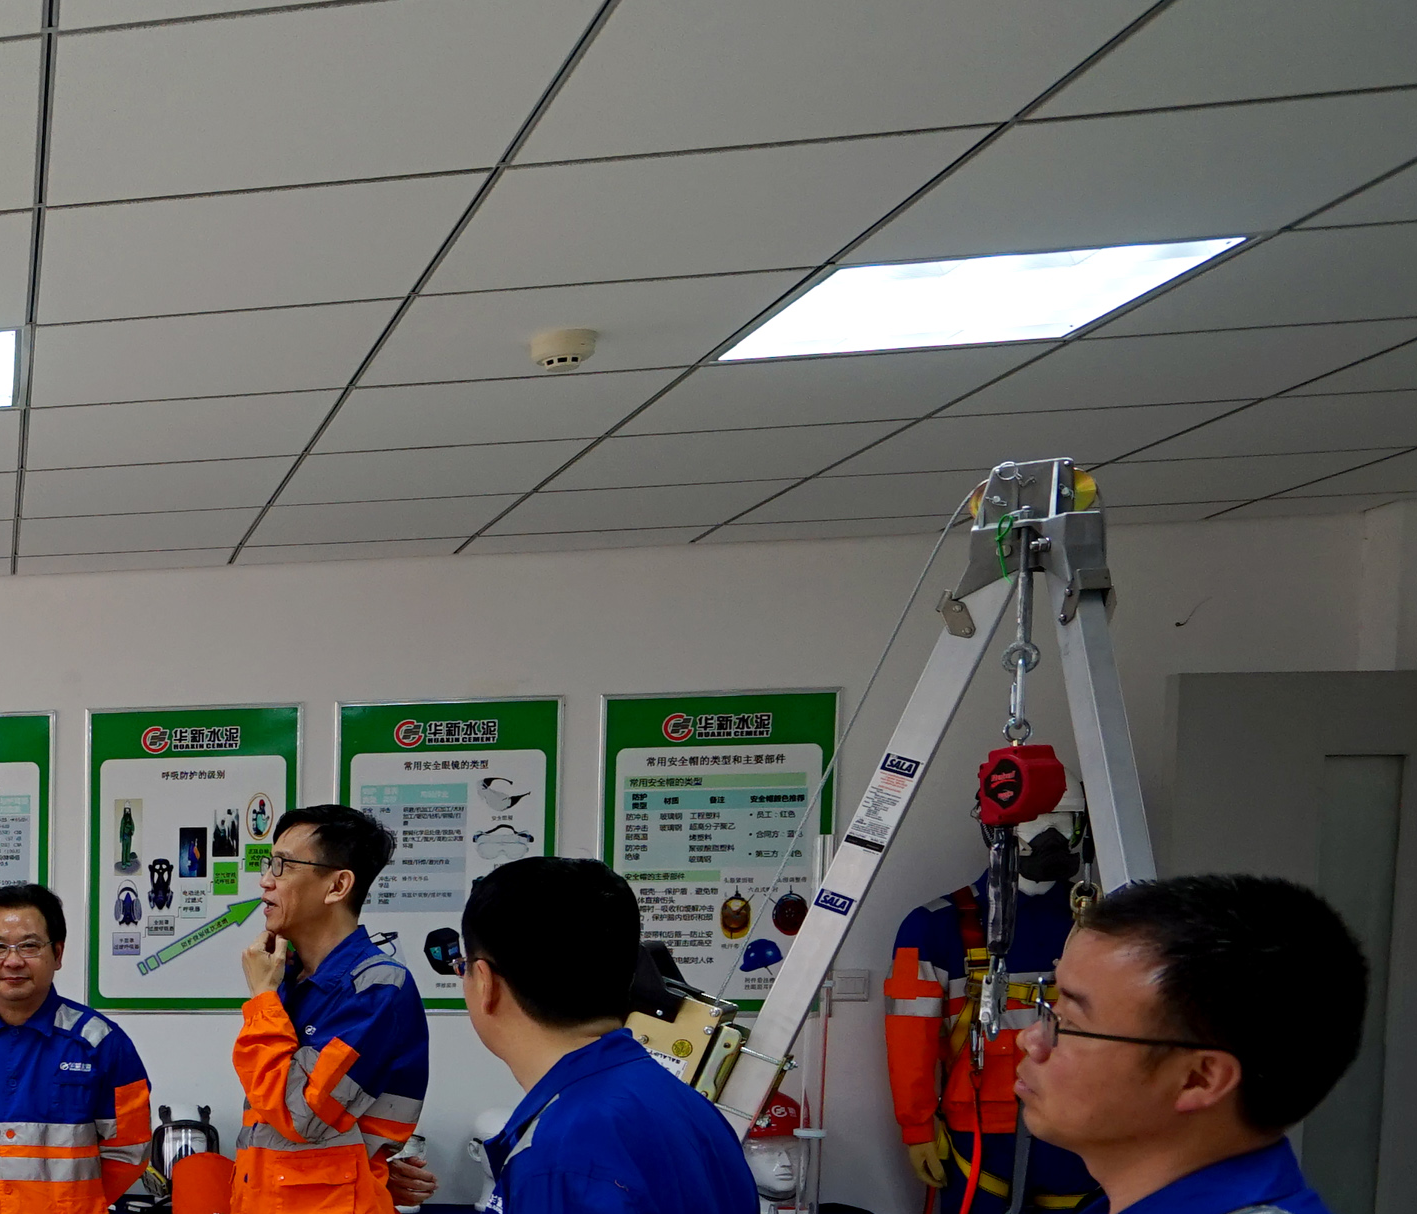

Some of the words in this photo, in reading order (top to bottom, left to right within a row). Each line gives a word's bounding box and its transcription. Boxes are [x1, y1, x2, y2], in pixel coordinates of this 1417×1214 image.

[697, 714, 771, 731] 华新水泥
[427, 721, 497, 737] 华新水泥
[173, 727, 239, 743] 华新水泥
[646, 754, 787, 767] 常用安全帽的类型和主要部件
[403, 760, 490, 771] 常用安全眼镜的类型
[886, 758, 913, 774] SALA
[161, 770, 226, 780] 呼吸防护的级别
[629, 777, 703, 787] 常用安全帽的类型
[632, 793, 648, 801] 防护
[663, 797, 679, 805] 材质
[709, 796, 725, 804] 备注
[750, 794, 805, 803] 安全帽颜色推荐
[632, 802, 648, 810] 类型
[625, 813, 649, 821] 防冲击
[659, 812, 683, 821] 玻璃钢
[689, 812, 720, 820] 工程塑料
[756, 810, 796, 818] 员工：红色
[625, 824, 649, 832] 防冲击
[659, 823, 683, 832] 玻璃钢
[689, 822, 736, 831] 超高分子聚乙
[625, 833, 649, 841] 耐高温
[624, 844, 648, 852] 防冲击
[624, 872, 686, 881] 安全帽的主要部件
[820, 894, 847, 910] SALA
